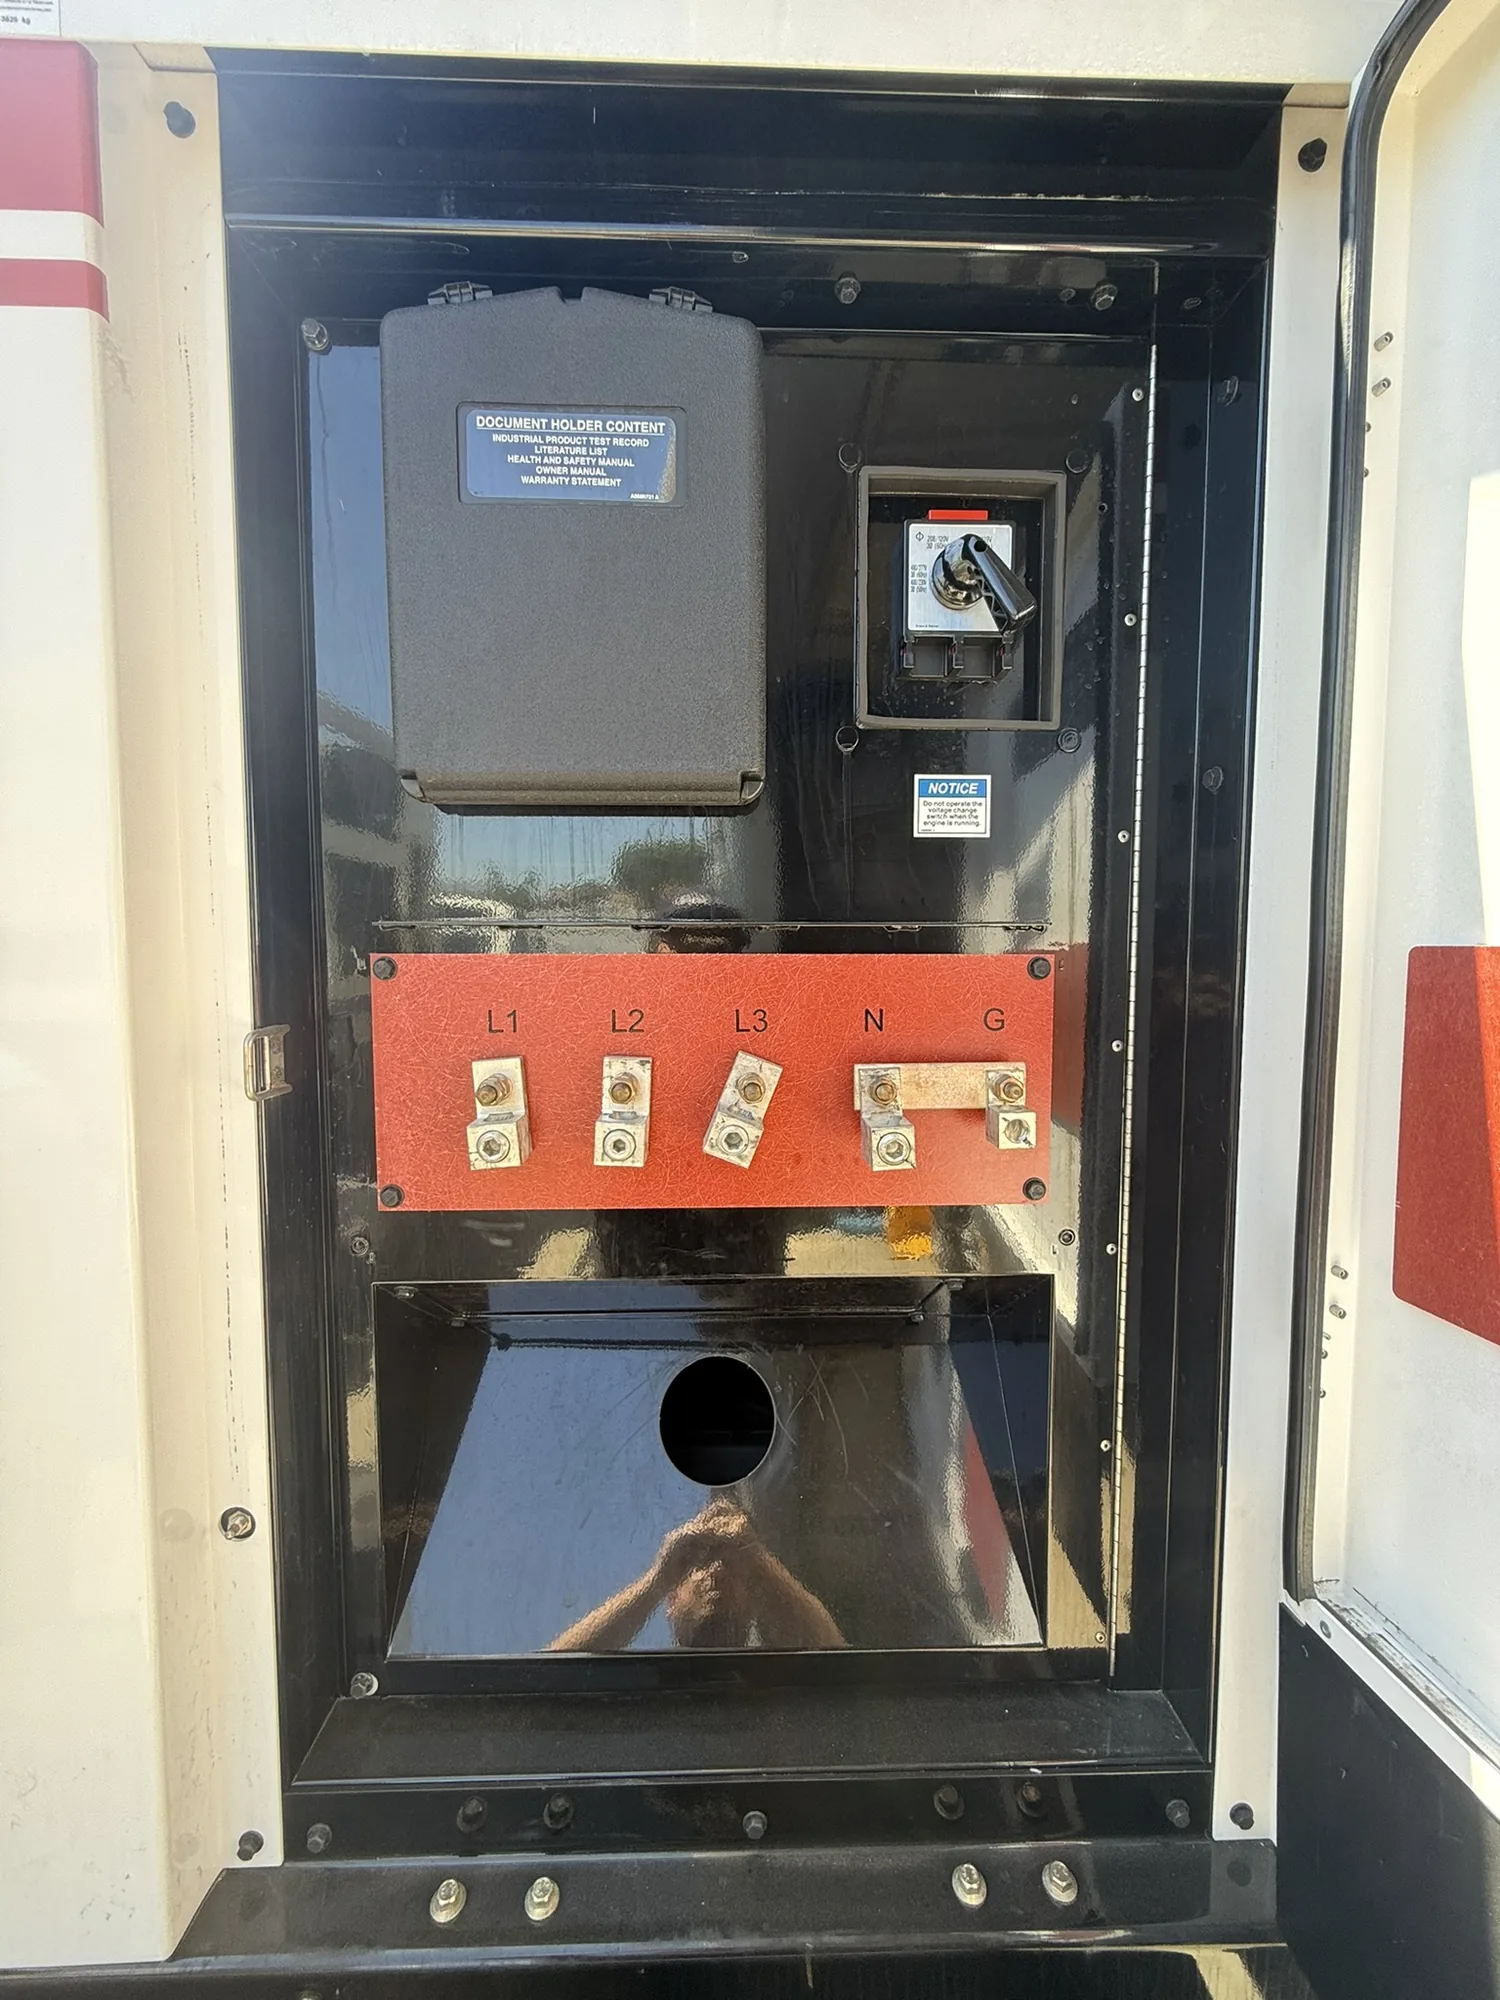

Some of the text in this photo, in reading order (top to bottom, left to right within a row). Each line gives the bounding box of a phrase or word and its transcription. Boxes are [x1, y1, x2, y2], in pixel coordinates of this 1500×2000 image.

[476, 416, 666, 434] DOCUMENT HOLDER CONTENT
[492, 433, 649, 447] INDUSTRIAL PRODUCT TEST RECORD
[534, 446, 608, 456] LITERATURE LIST
[508, 455, 635, 467] HEALTH AND SAFETY MANUAL
[536, 466, 607, 476] OWNER MANUAL
[521, 475, 622, 487] WARRANTY STATEMENT
[928, 782, 979, 794] NOTICE
[488, 1008, 1006, 1034] L1 L2 L3 N G
